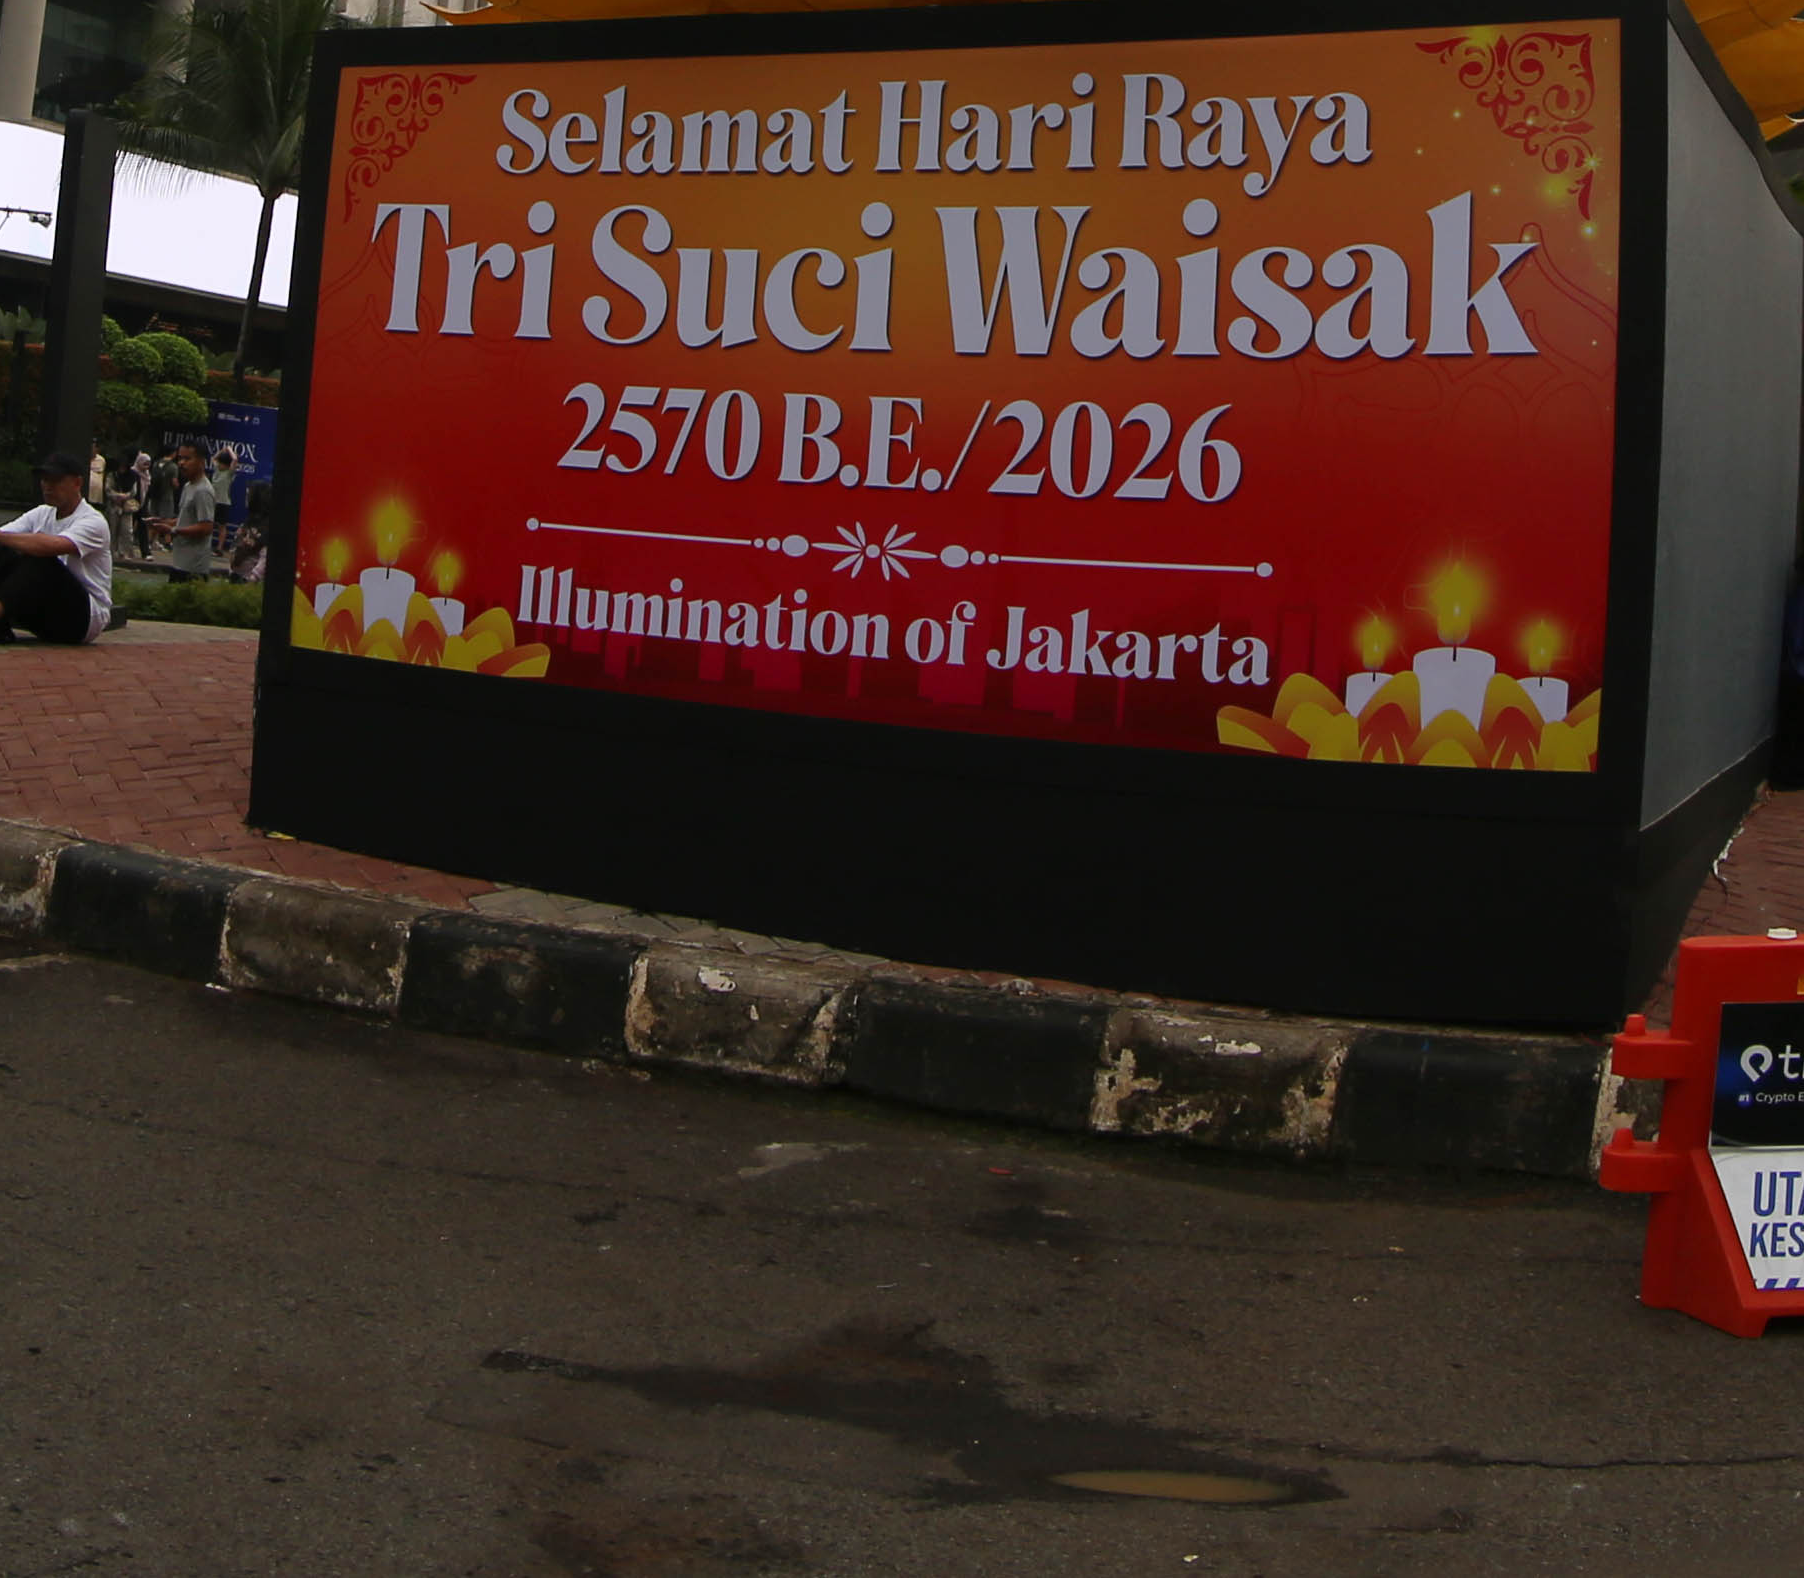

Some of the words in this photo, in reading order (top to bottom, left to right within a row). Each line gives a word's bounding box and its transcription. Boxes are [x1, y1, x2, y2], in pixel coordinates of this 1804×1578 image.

[496, 83, 857, 178] Selamat
[877, 72, 1098, 174] Hari
[1119, 72, 1374, 197] Raya
[372, 201, 555, 341] Tri
[581, 201, 895, 354] Suci
[935, 191, 1542, 360] Waisak
[556, 383, 762, 482] 2570
[515, 564, 891, 659] Illumination
[904, 598, 975, 666] of
[985, 605, 1273, 687] Jakarta
[1755, 1090, 1795, 1105] Crypto
